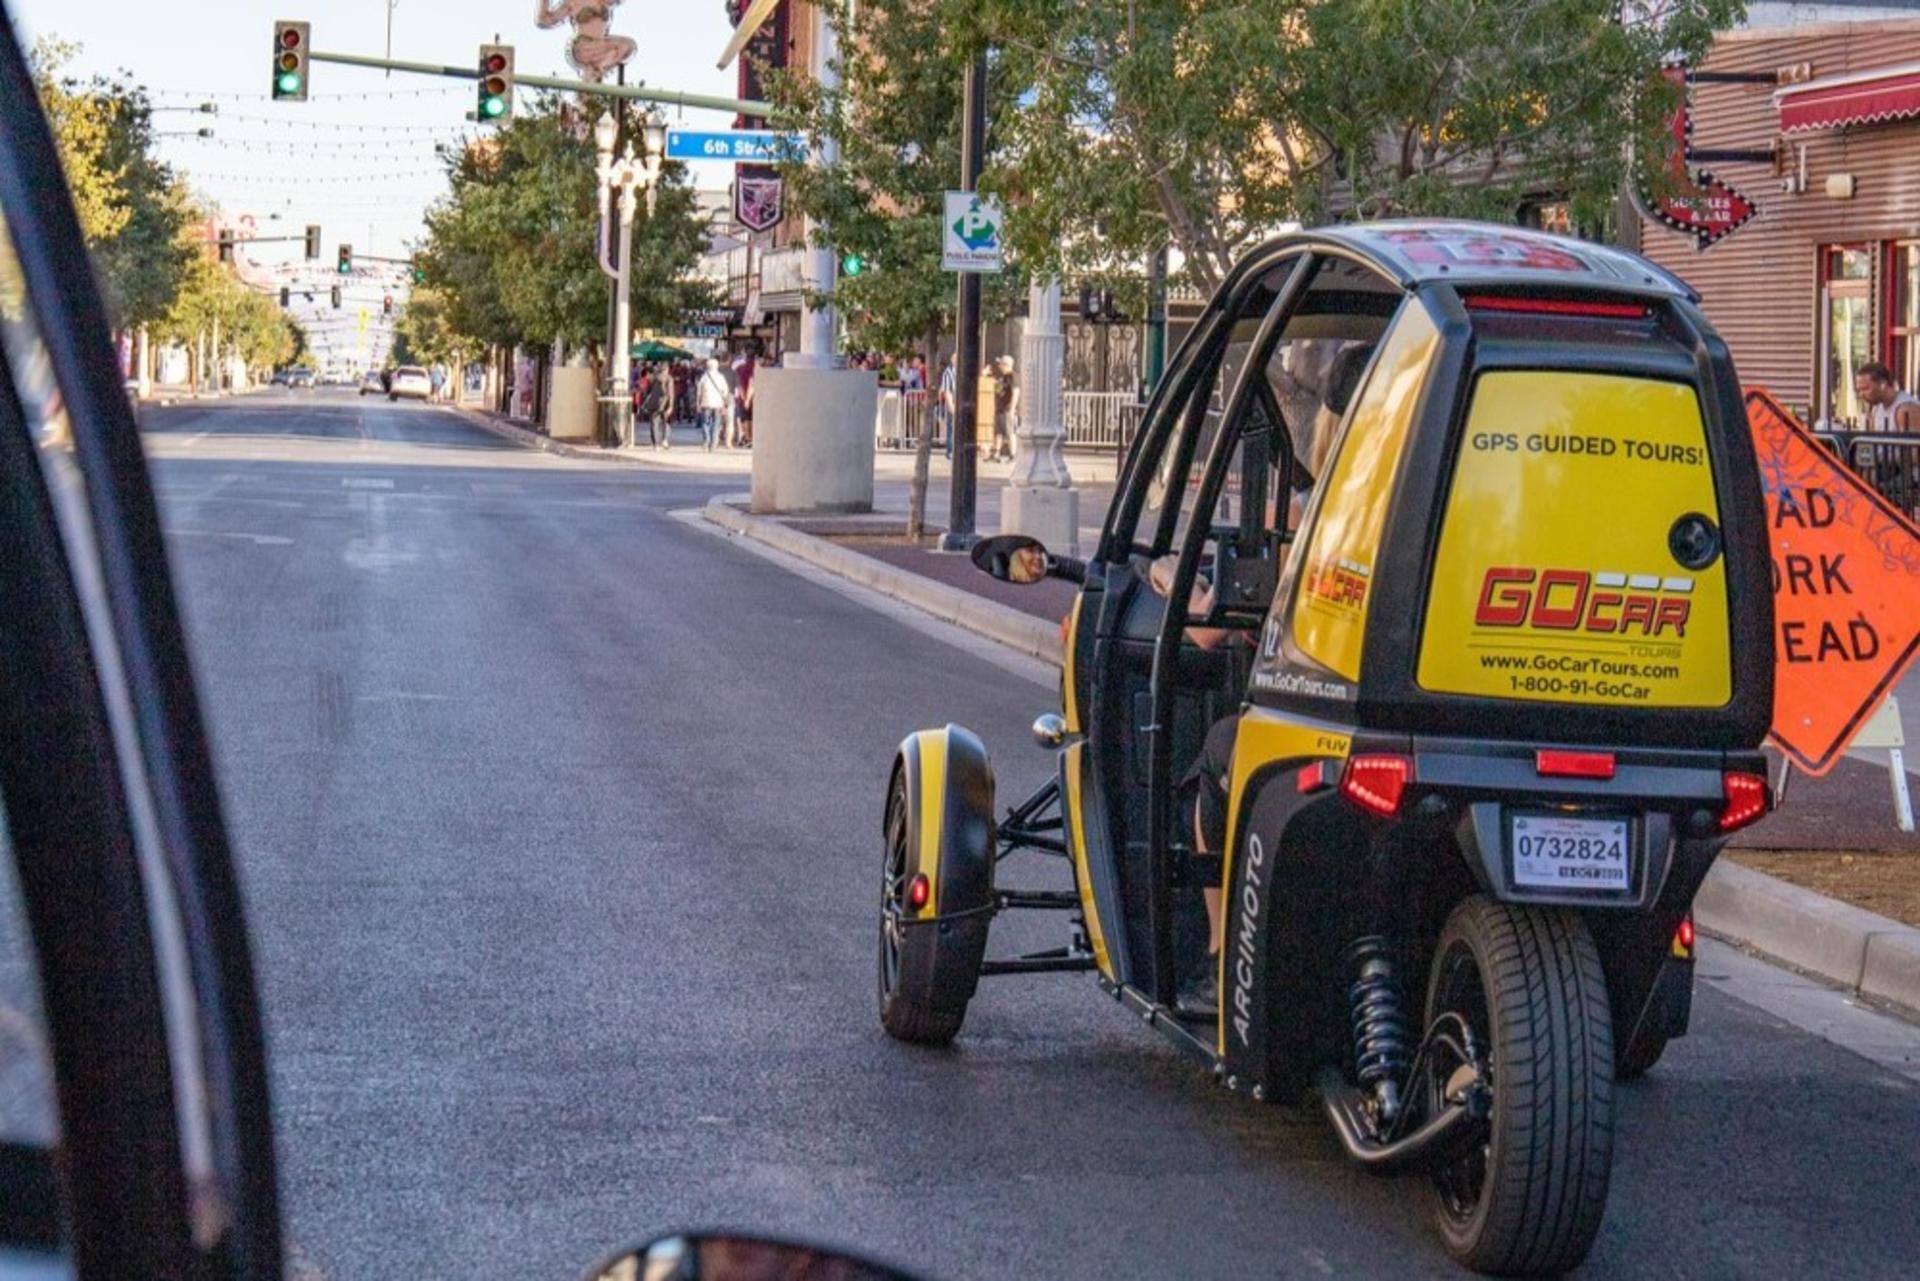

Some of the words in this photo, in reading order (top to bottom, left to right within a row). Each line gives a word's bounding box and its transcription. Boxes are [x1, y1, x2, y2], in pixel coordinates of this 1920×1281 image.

[703, 139, 729, 154] 6th
[733, 140, 777, 156] Str
[1472, 432, 1519, 452] GPS
[1526, 433, 1617, 457] GUIDED
[1623, 438, 1705, 466] TOURS!
[1775, 487, 1835, 529] AD
[1773, 553, 1853, 595] RK
[1629, 645, 1682, 660] TOURS
[1781, 618, 1881, 664] EAD
[1480, 654, 1680, 680] www.GoCarTours.com
[1255, 671, 1347, 699] www.GoCarTours.com
[1510, 675, 1651, 700] 1-800-91-GoCar
[1316, 736, 1348, 752] FUV
[1519, 834, 1623, 862] 0732824
[1233, 832, 1264, 1047] ARCIMOTO
